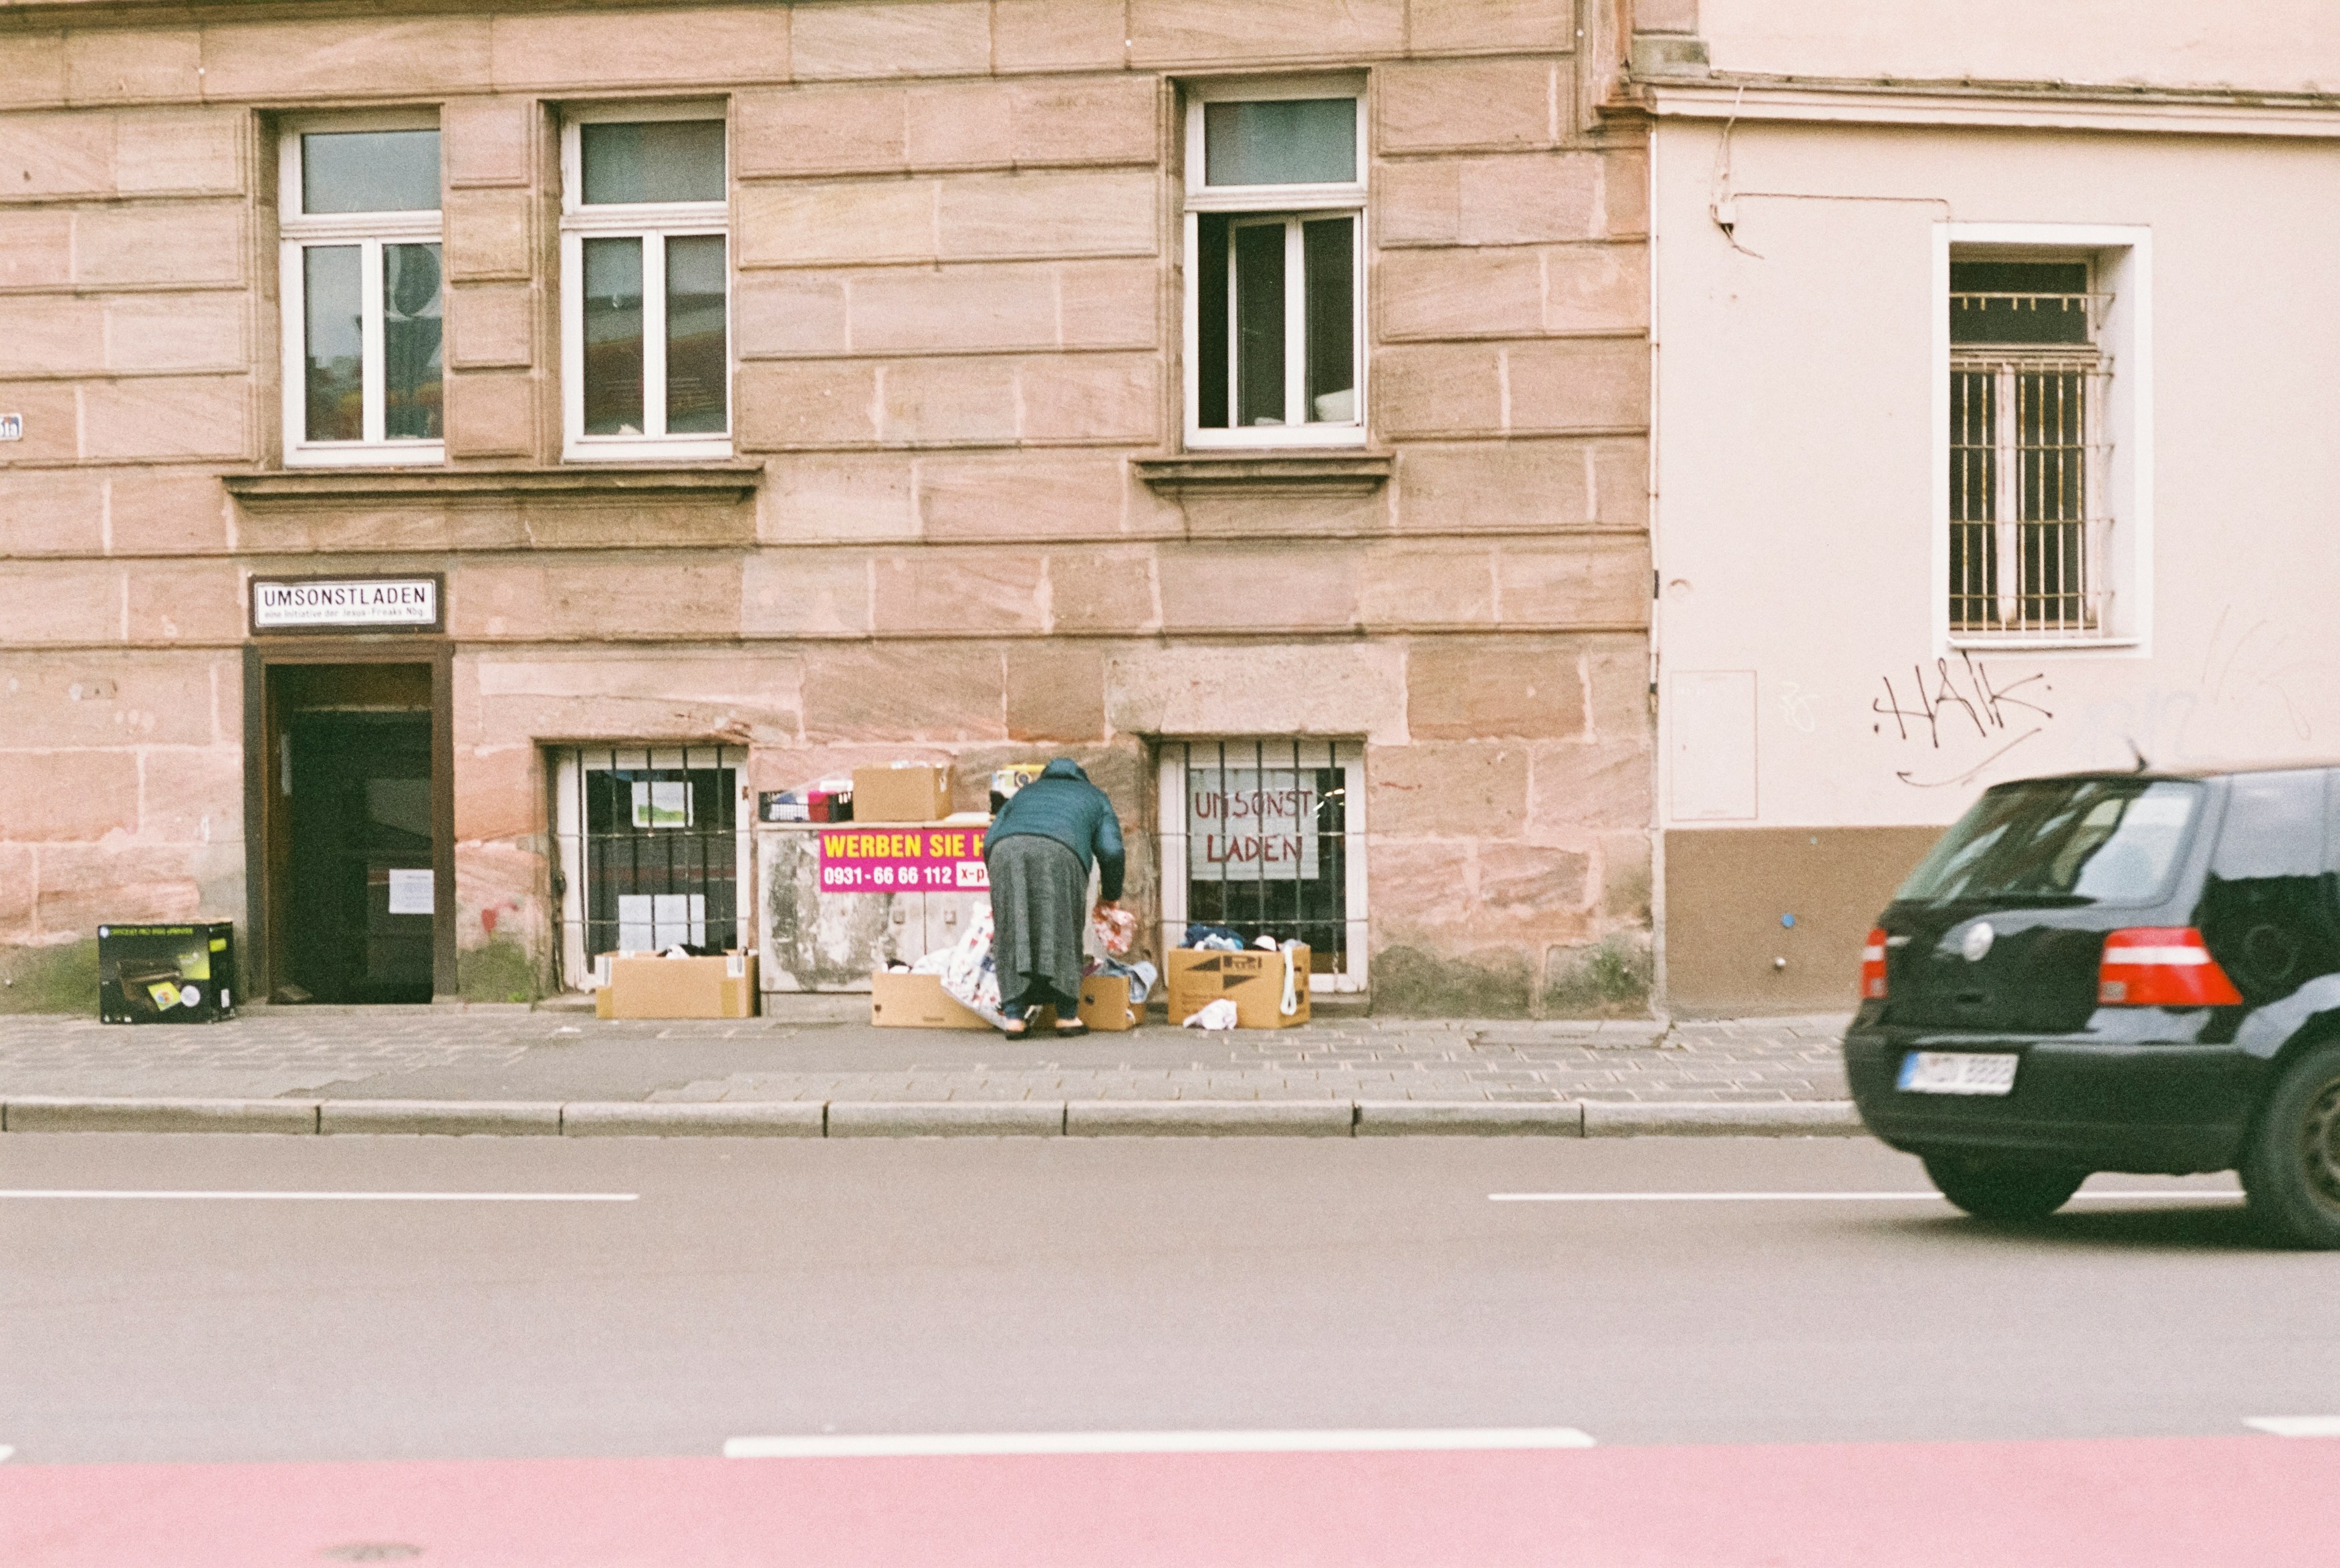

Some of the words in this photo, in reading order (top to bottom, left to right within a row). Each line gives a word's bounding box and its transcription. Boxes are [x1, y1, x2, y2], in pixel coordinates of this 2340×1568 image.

[264, 587, 425, 607] UMSONSTLADEN
[325, 608, 340, 617] der
[1195, 791, 1313, 819] UMSONST
[824, 834, 921, 858] WERBEN
[929, 834, 965, 858] SIE
[1207, 834, 1302, 863] LADEN
[898, 866, 919, 885] 66
[923, 866, 952, 884] 112
[961, 868, 988, 880] x-p
